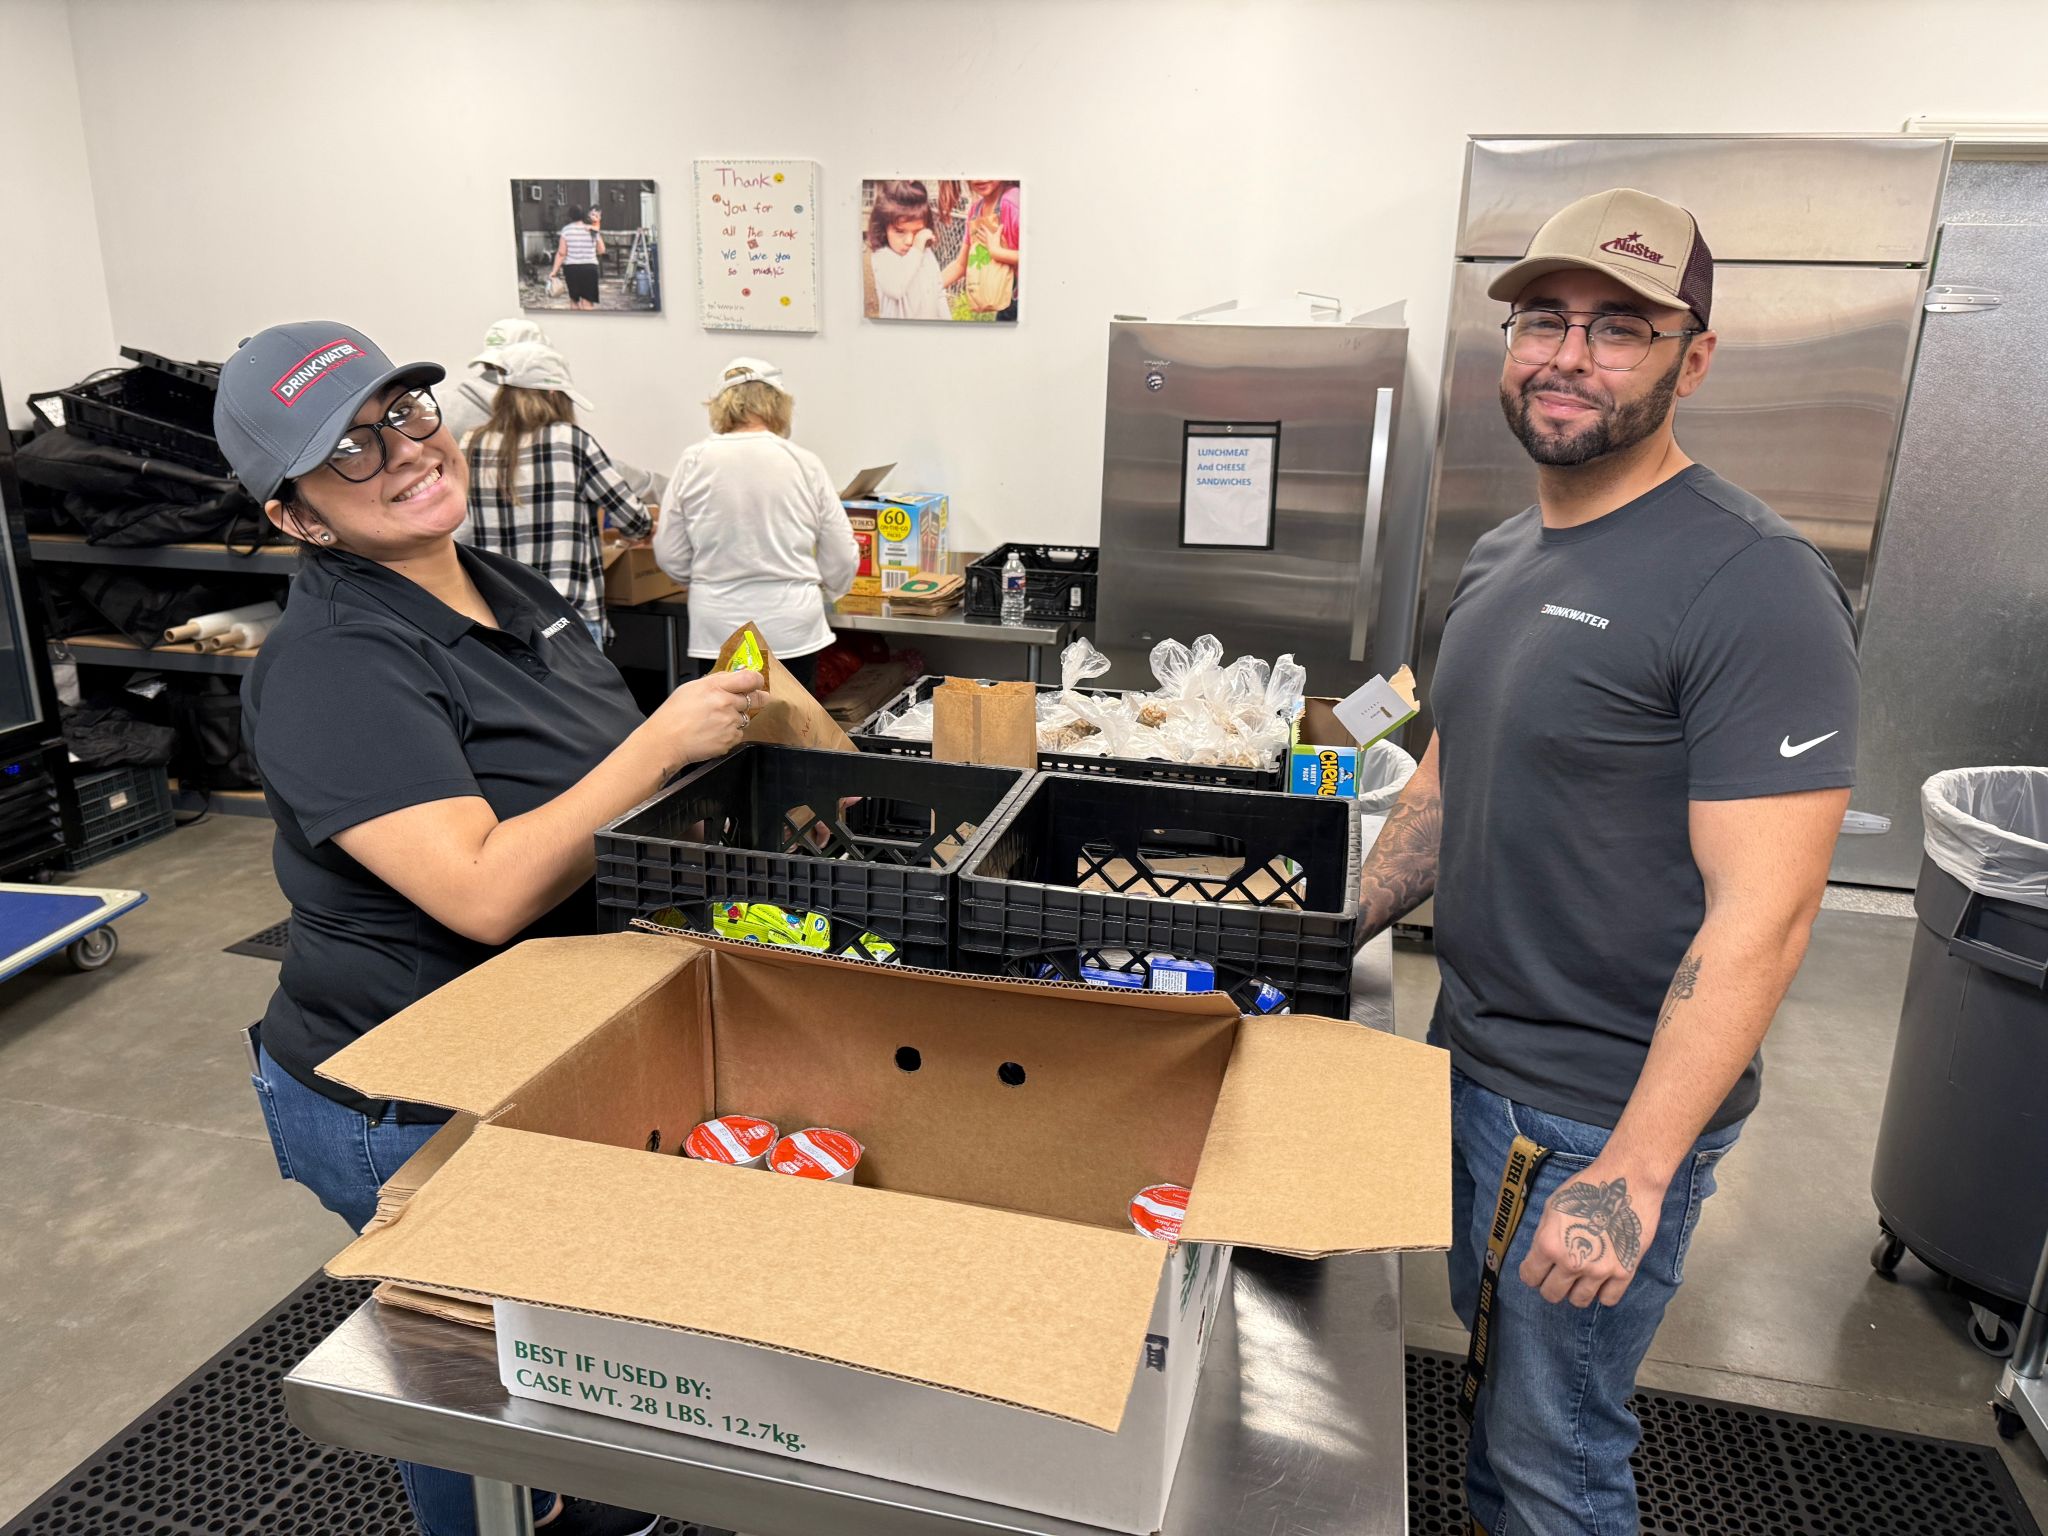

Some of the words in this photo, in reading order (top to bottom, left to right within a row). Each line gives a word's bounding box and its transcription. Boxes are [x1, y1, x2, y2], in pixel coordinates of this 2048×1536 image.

[714, 167, 772, 188] Thank
[753, 202, 773, 214] for
[722, 225, 736, 236] all
[1613, 238, 1664, 262] NuStar
[280, 344, 358, 398] DRINKWATER
[1198, 449, 1250, 457] LUNCHMEAT
[1197, 463, 1214, 471] And
[1216, 463, 1246, 471] CHEESE
[1196, 478, 1252, 486] SANDWICHES
[884, 510, 906, 526] 60
[1540, 604, 1610, 630] DRINKWATER
[1506, 1151, 1527, 1186] STEEL
[1492, 1188, 1516, 1243] CURTAIN
[1481, 1279, 1493, 1313] STEEL
[1475, 1313, 1489, 1366] CURTAIN
[514, 1340, 567, 1368] BEST
[575, 1353, 597, 1374] IF
[603, 1359, 668, 1390] USED
[676, 1375, 712, 1400] BY:
[516, 1368, 573, 1397] CASE
[577, 1381, 623, 1408] WT.
[630, 1394, 658, 1415] 28
[666, 1401, 713, 1428] LBS.
[721, 1415, 807, 1453] 12.7kg.
